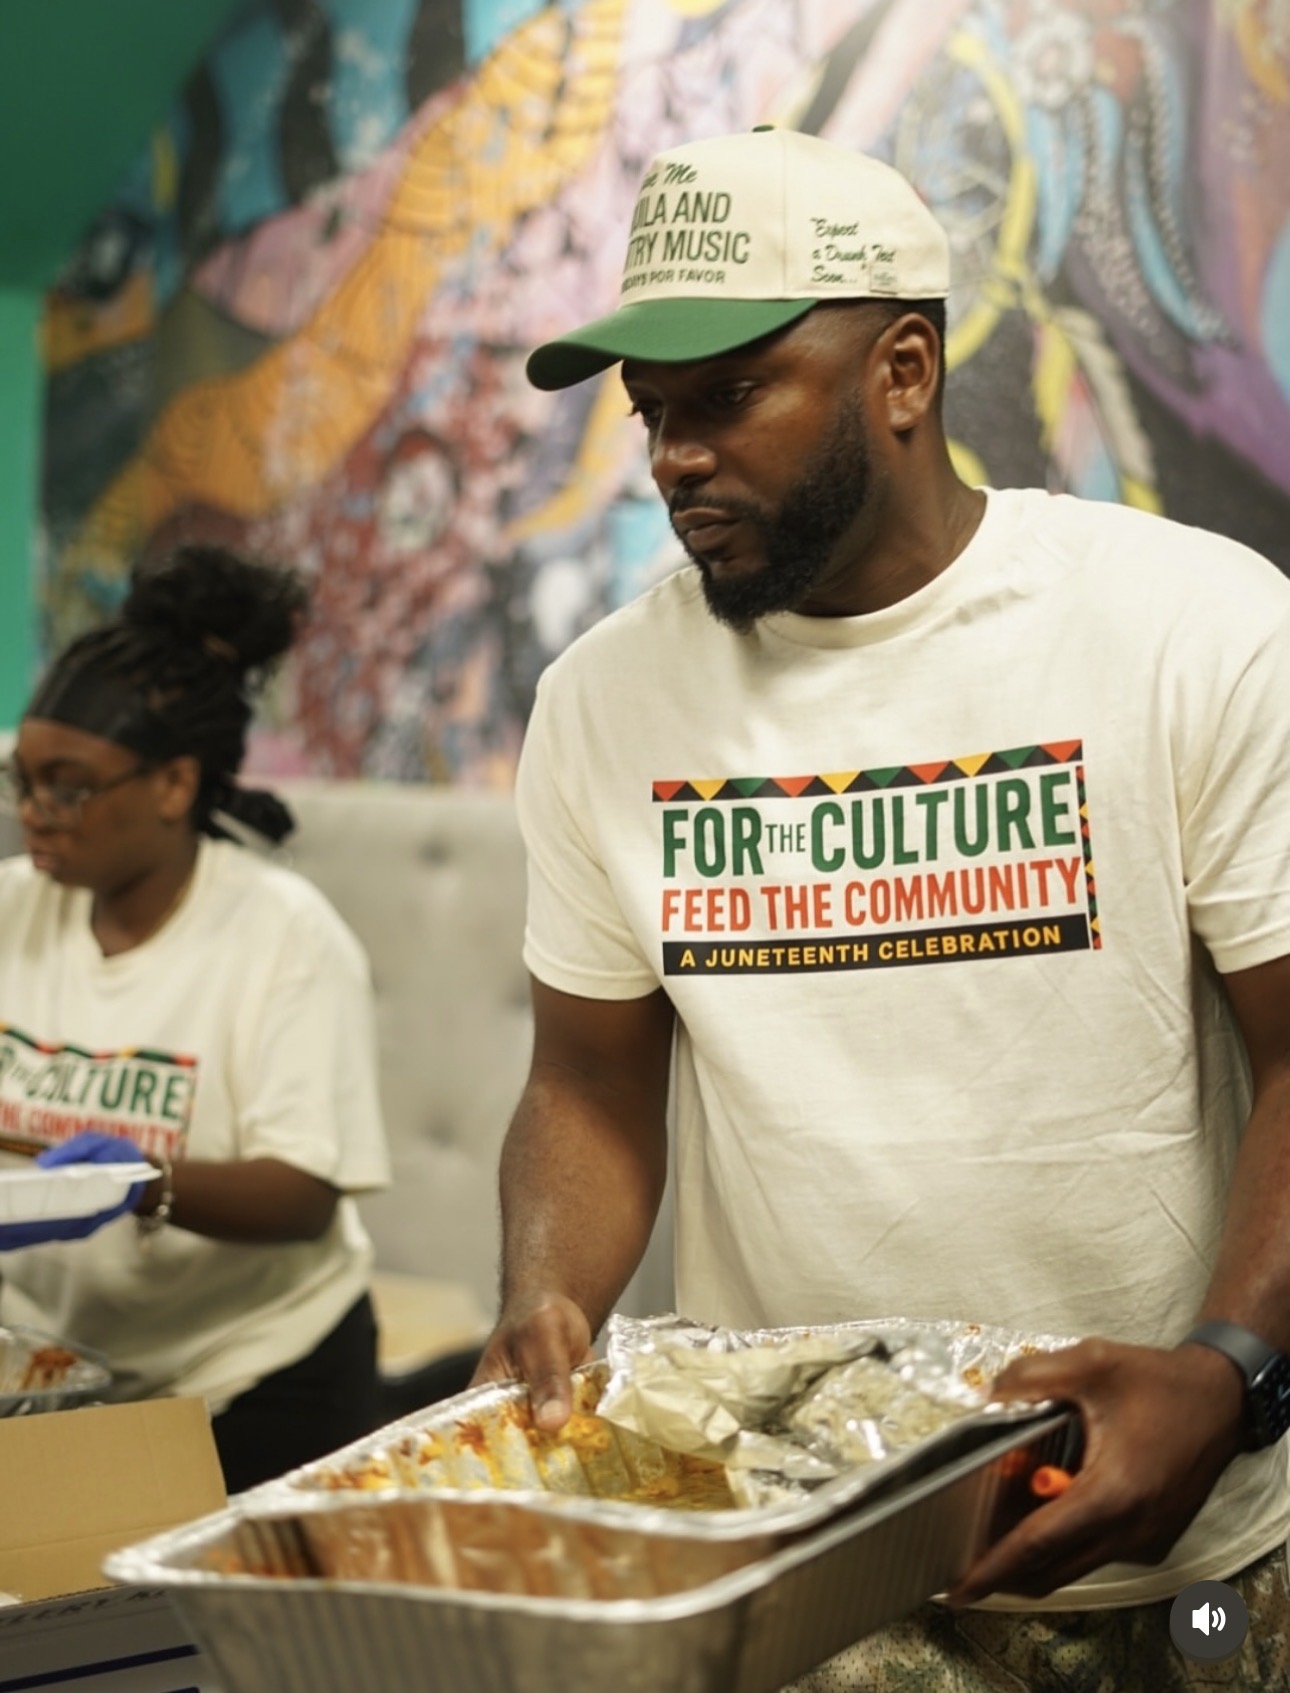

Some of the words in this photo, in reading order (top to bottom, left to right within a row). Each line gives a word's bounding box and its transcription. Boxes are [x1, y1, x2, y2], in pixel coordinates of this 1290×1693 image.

[663, 163, 698, 185] Me
[672, 191, 732, 224] AND
[662, 229, 752, 265] MUSIC
[650, 269, 675, 284] POR
[679, 268, 726, 284] FAVOR
[662, 805, 765, 879] FOR
[765, 822, 807, 854] THE
[810, 770, 1077, 873] CULTURE
[661, 886, 751, 933] FEED
[760, 882, 833, 931] THE
[844, 856, 1082, 927] COMMUNITY
[679, 948, 696, 968] A
[705, 943, 870, 968] JUNETEENTH
[878, 924, 1062, 962] CELEBRATION
